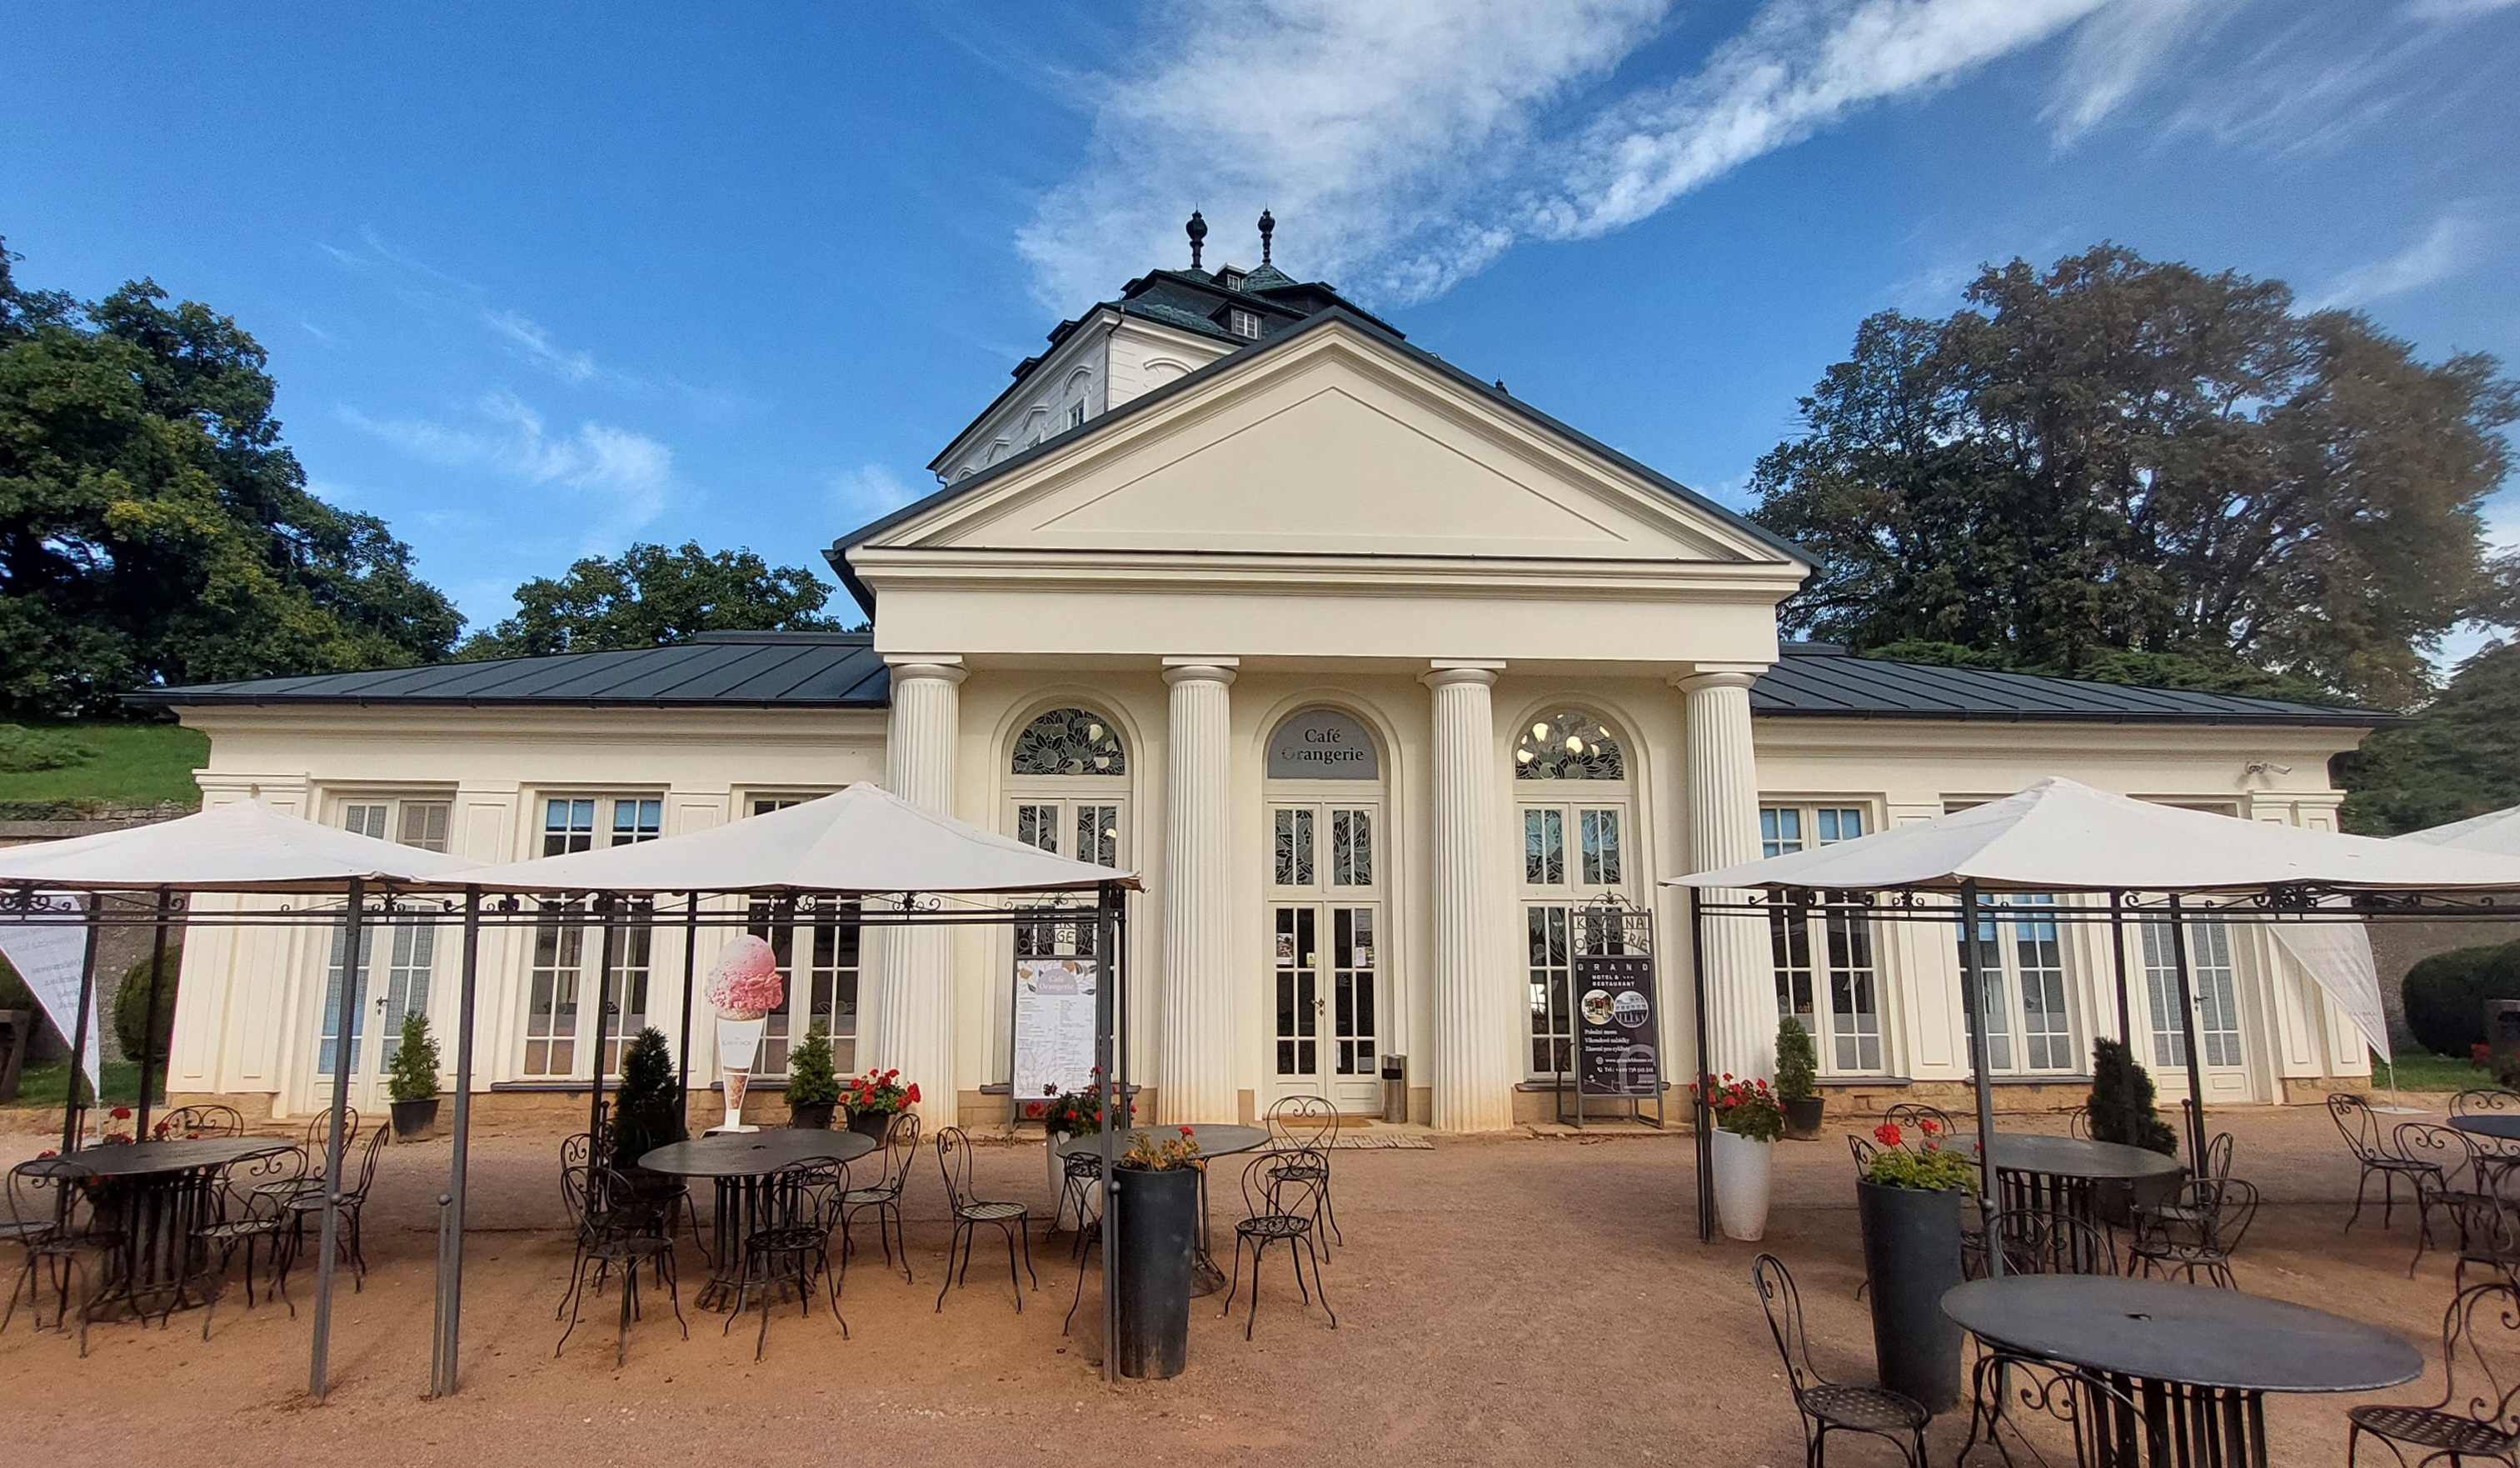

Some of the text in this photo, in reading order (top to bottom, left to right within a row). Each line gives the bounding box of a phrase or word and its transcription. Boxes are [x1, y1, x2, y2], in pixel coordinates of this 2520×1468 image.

[1304, 728, 1340, 743] Café
[1281, 746, 1365, 765] Orangerie
[1577, 963, 1649, 971] GRAND
